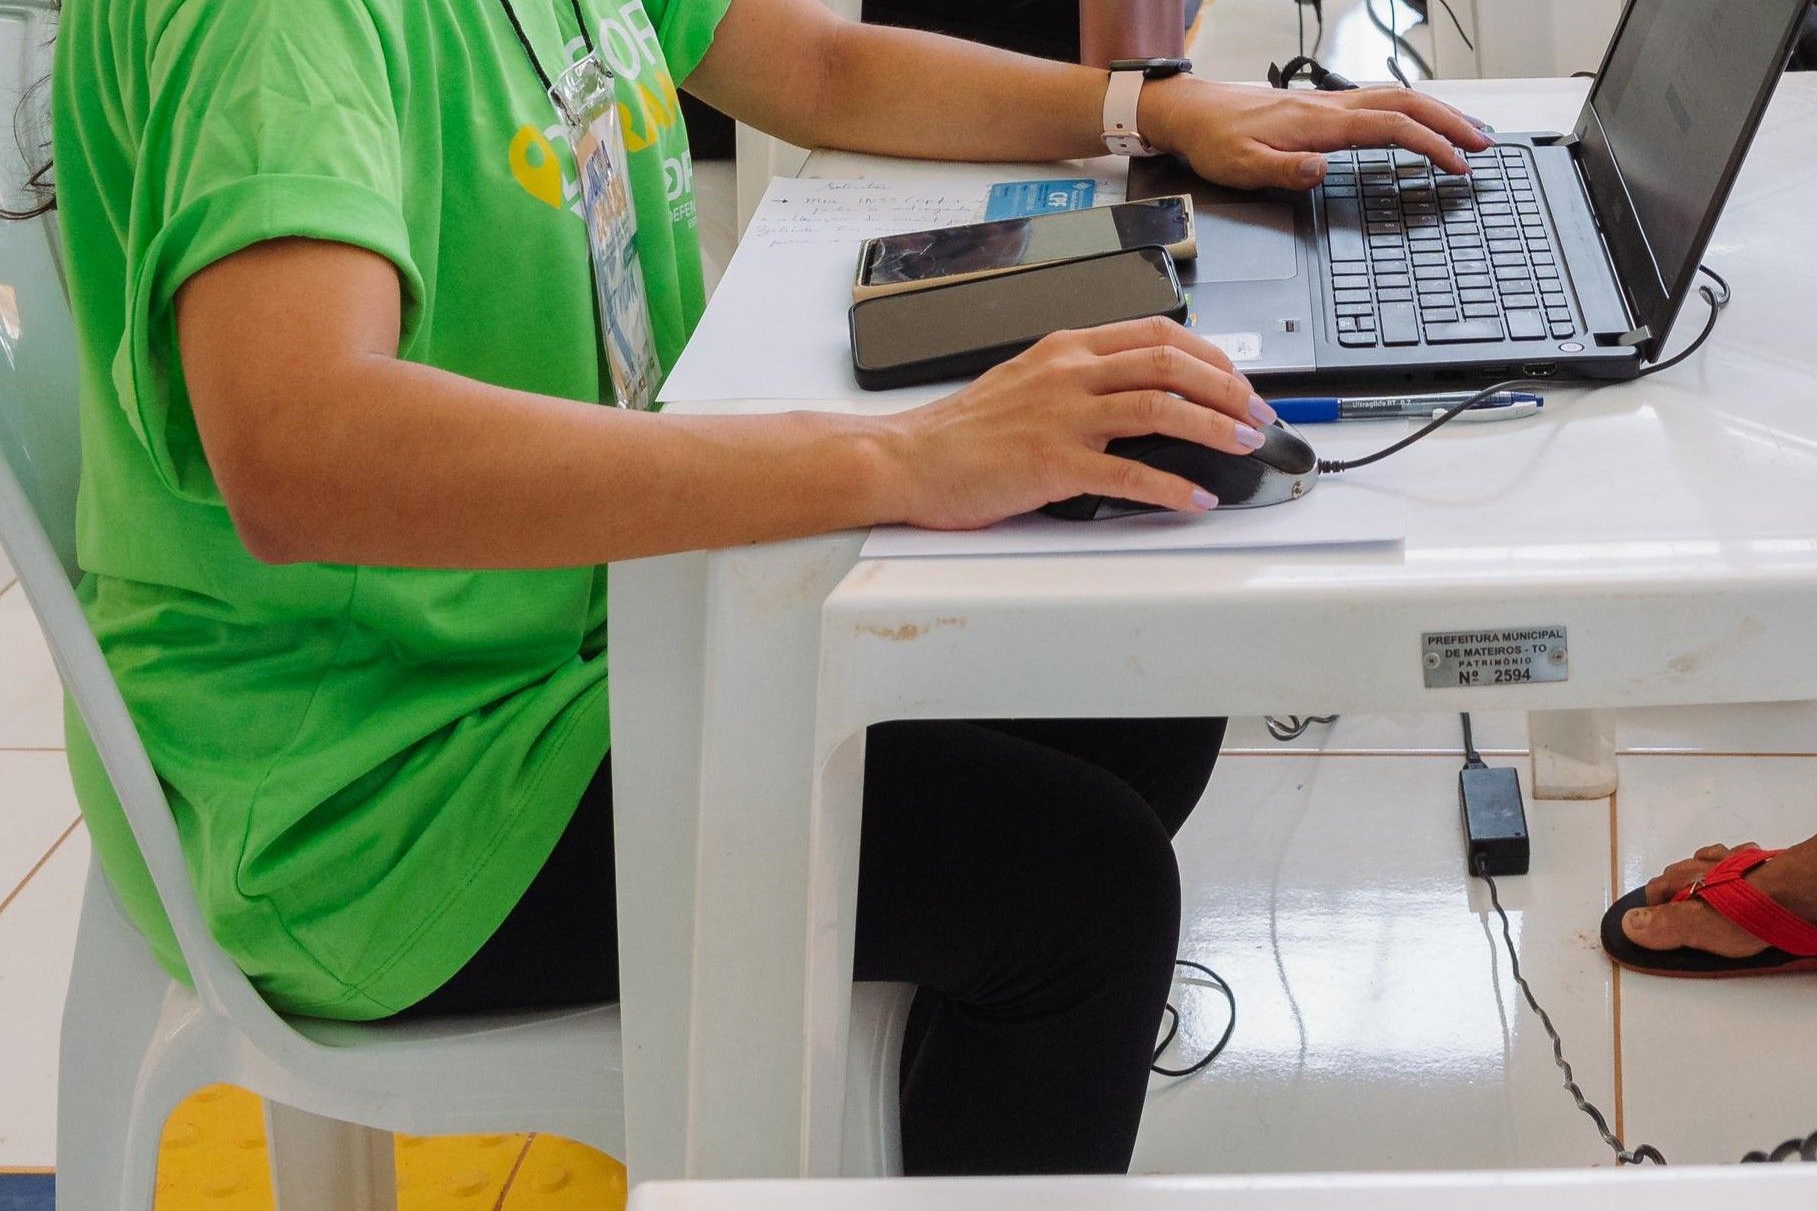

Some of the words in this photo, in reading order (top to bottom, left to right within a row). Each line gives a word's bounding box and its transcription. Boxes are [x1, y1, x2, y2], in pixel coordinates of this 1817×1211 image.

[1428, 632, 1500, 646] PREFEITURA
[1502, 630, 1564, 643] MUNICIPAL
[1445, 648, 1460, 659] DE
[1463, 645, 1522, 658] MATEIROS
[1532, 644, 1547, 654] TO
[1494, 668, 1531, 683] 2594
